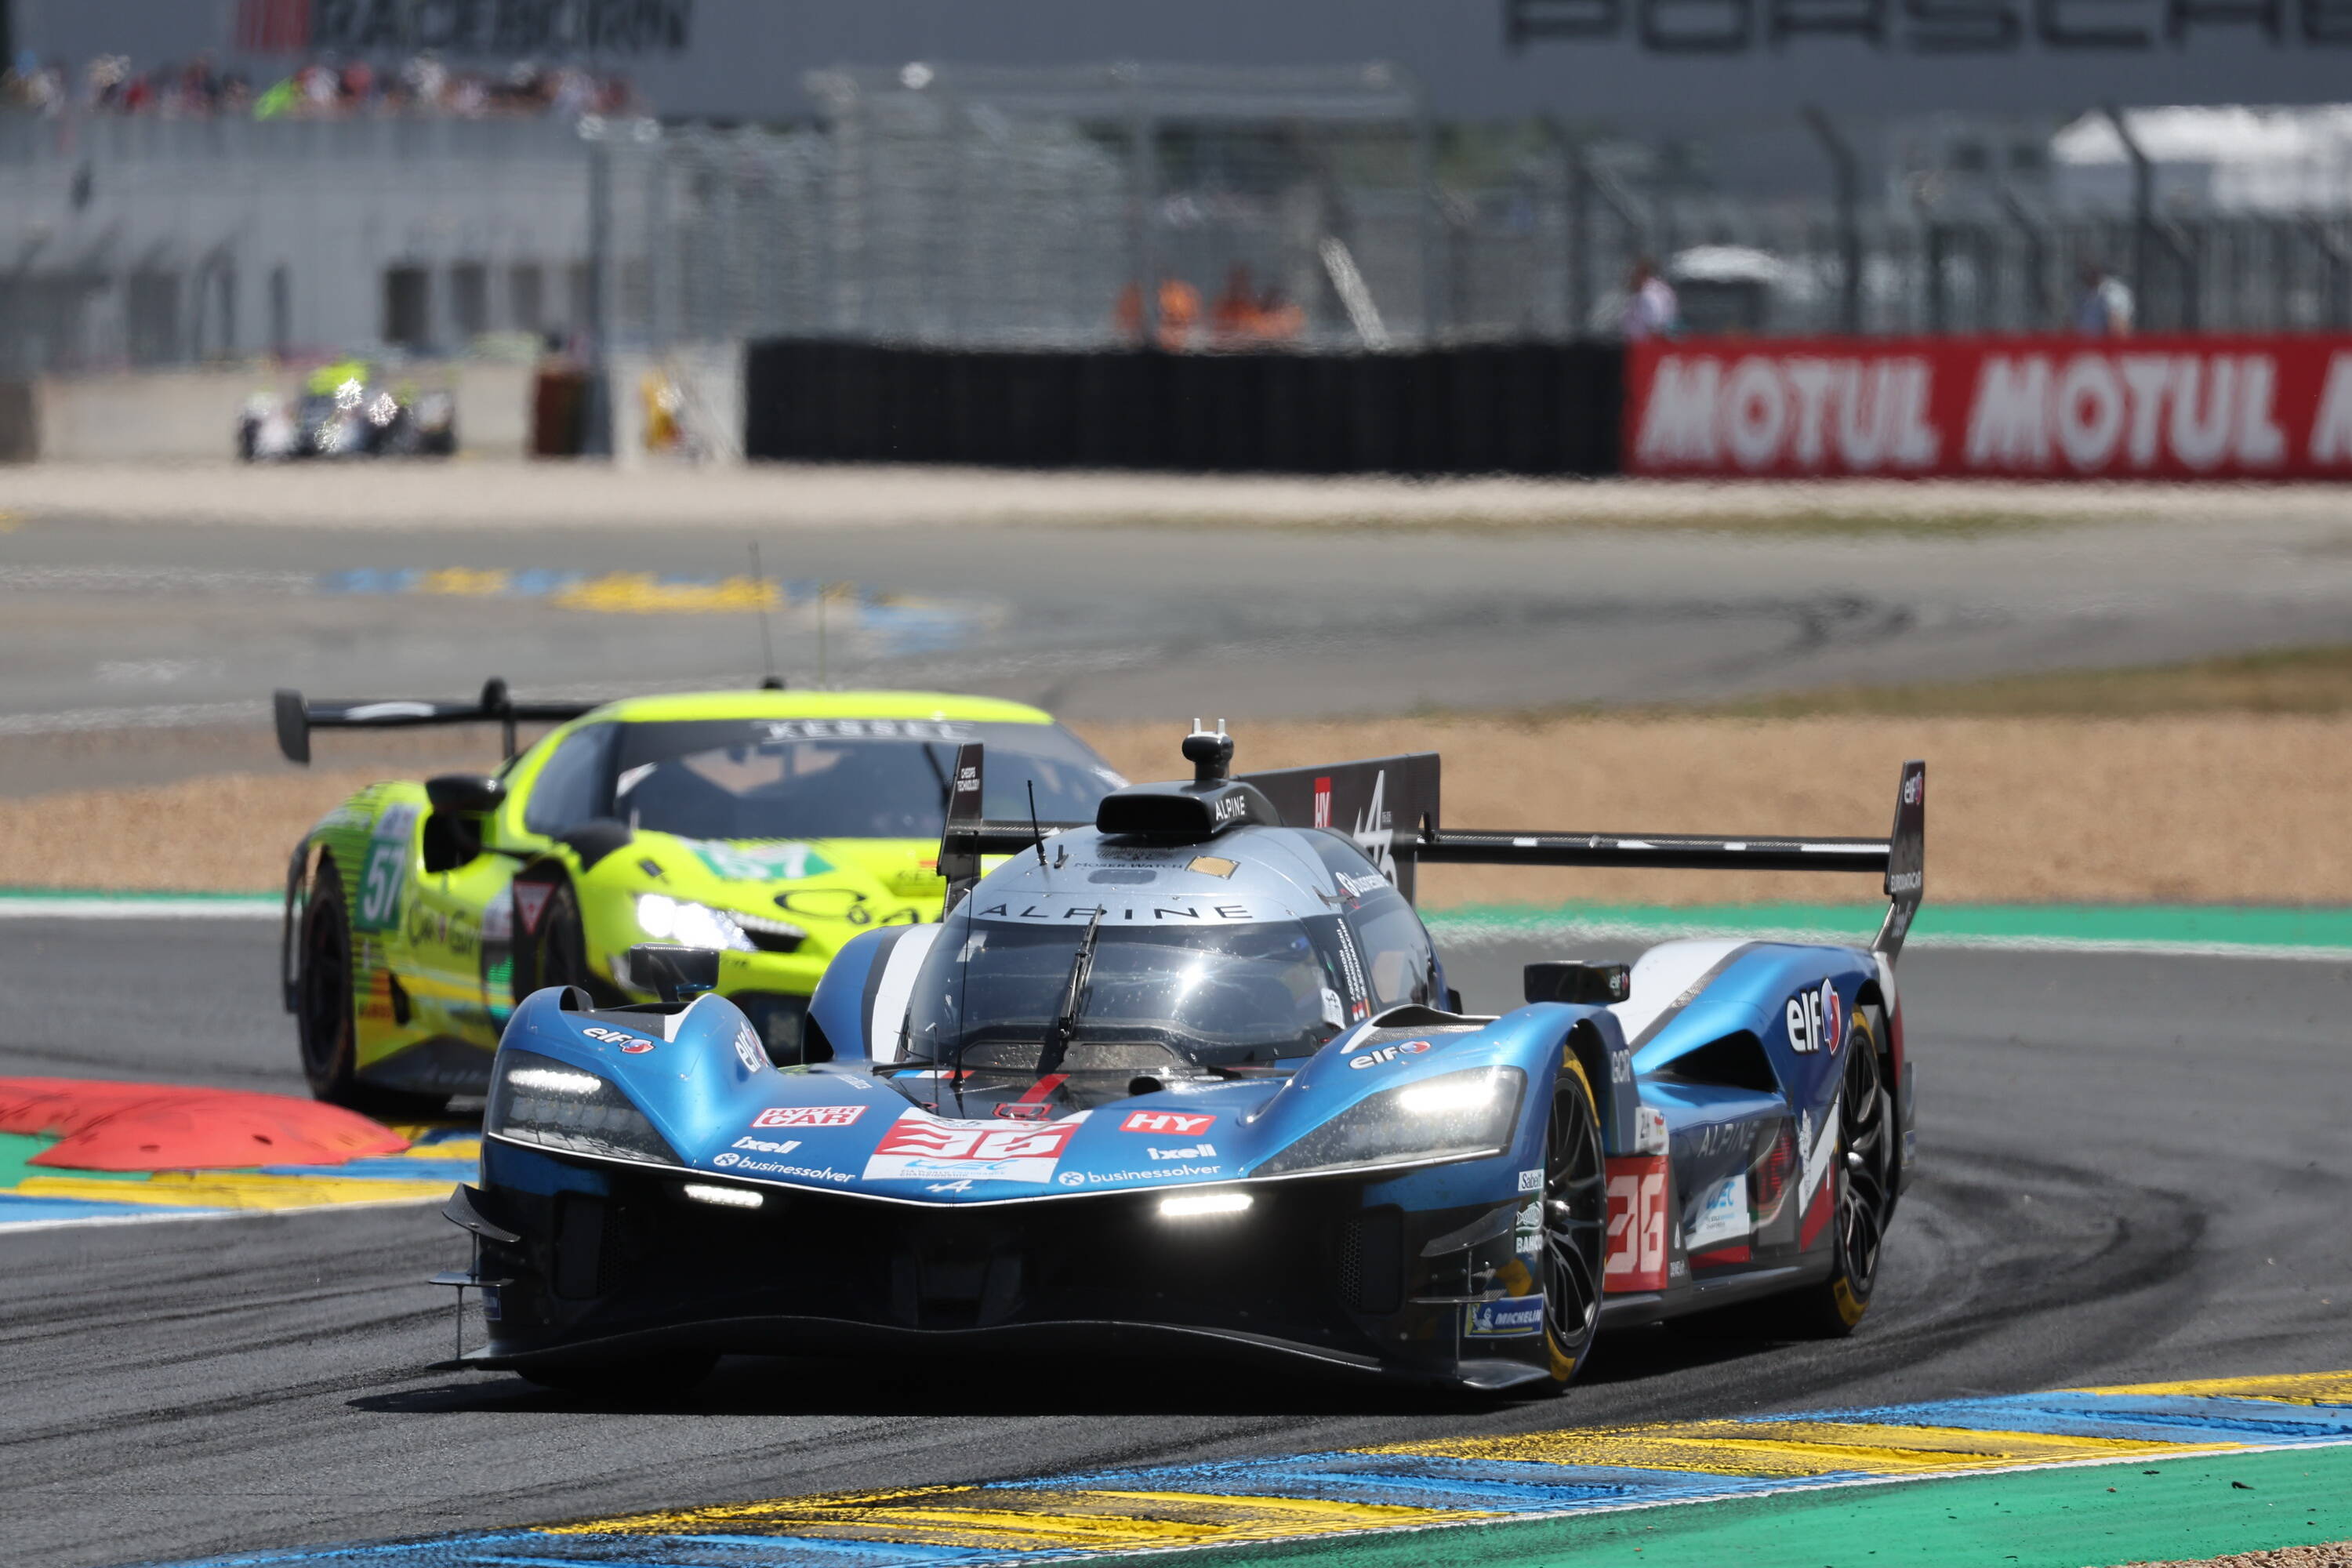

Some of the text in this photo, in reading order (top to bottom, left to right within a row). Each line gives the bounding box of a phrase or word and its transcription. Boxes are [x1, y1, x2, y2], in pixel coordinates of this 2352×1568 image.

[1636, 354, 1941, 466] MOTUL
[1965, 353, 2286, 467] MOTUL
[1215, 795, 1245, 821] ALPINE
[363, 845, 406, 922] 57
[978, 902, 1254, 920] ALPINE
[1786, 989, 1822, 1053] elf
[583, 1026, 632, 1044] elf
[1348, 1046, 1402, 1070] elf
[760, 1113, 851, 1125] CAR
[1126, 1113, 1210, 1131] HY
[882, 1123, 1073, 1159] 36
[1697, 1120, 1760, 1158] ALPINE
[737, 1156, 856, 1183] businessolver
[1087, 1164, 1221, 1183] businessolver
[1521, 1172, 1543, 1189] Sabelt
[1606, 1174, 1664, 1273] 36
[1494, 1308, 1542, 1326] MICHELIN
